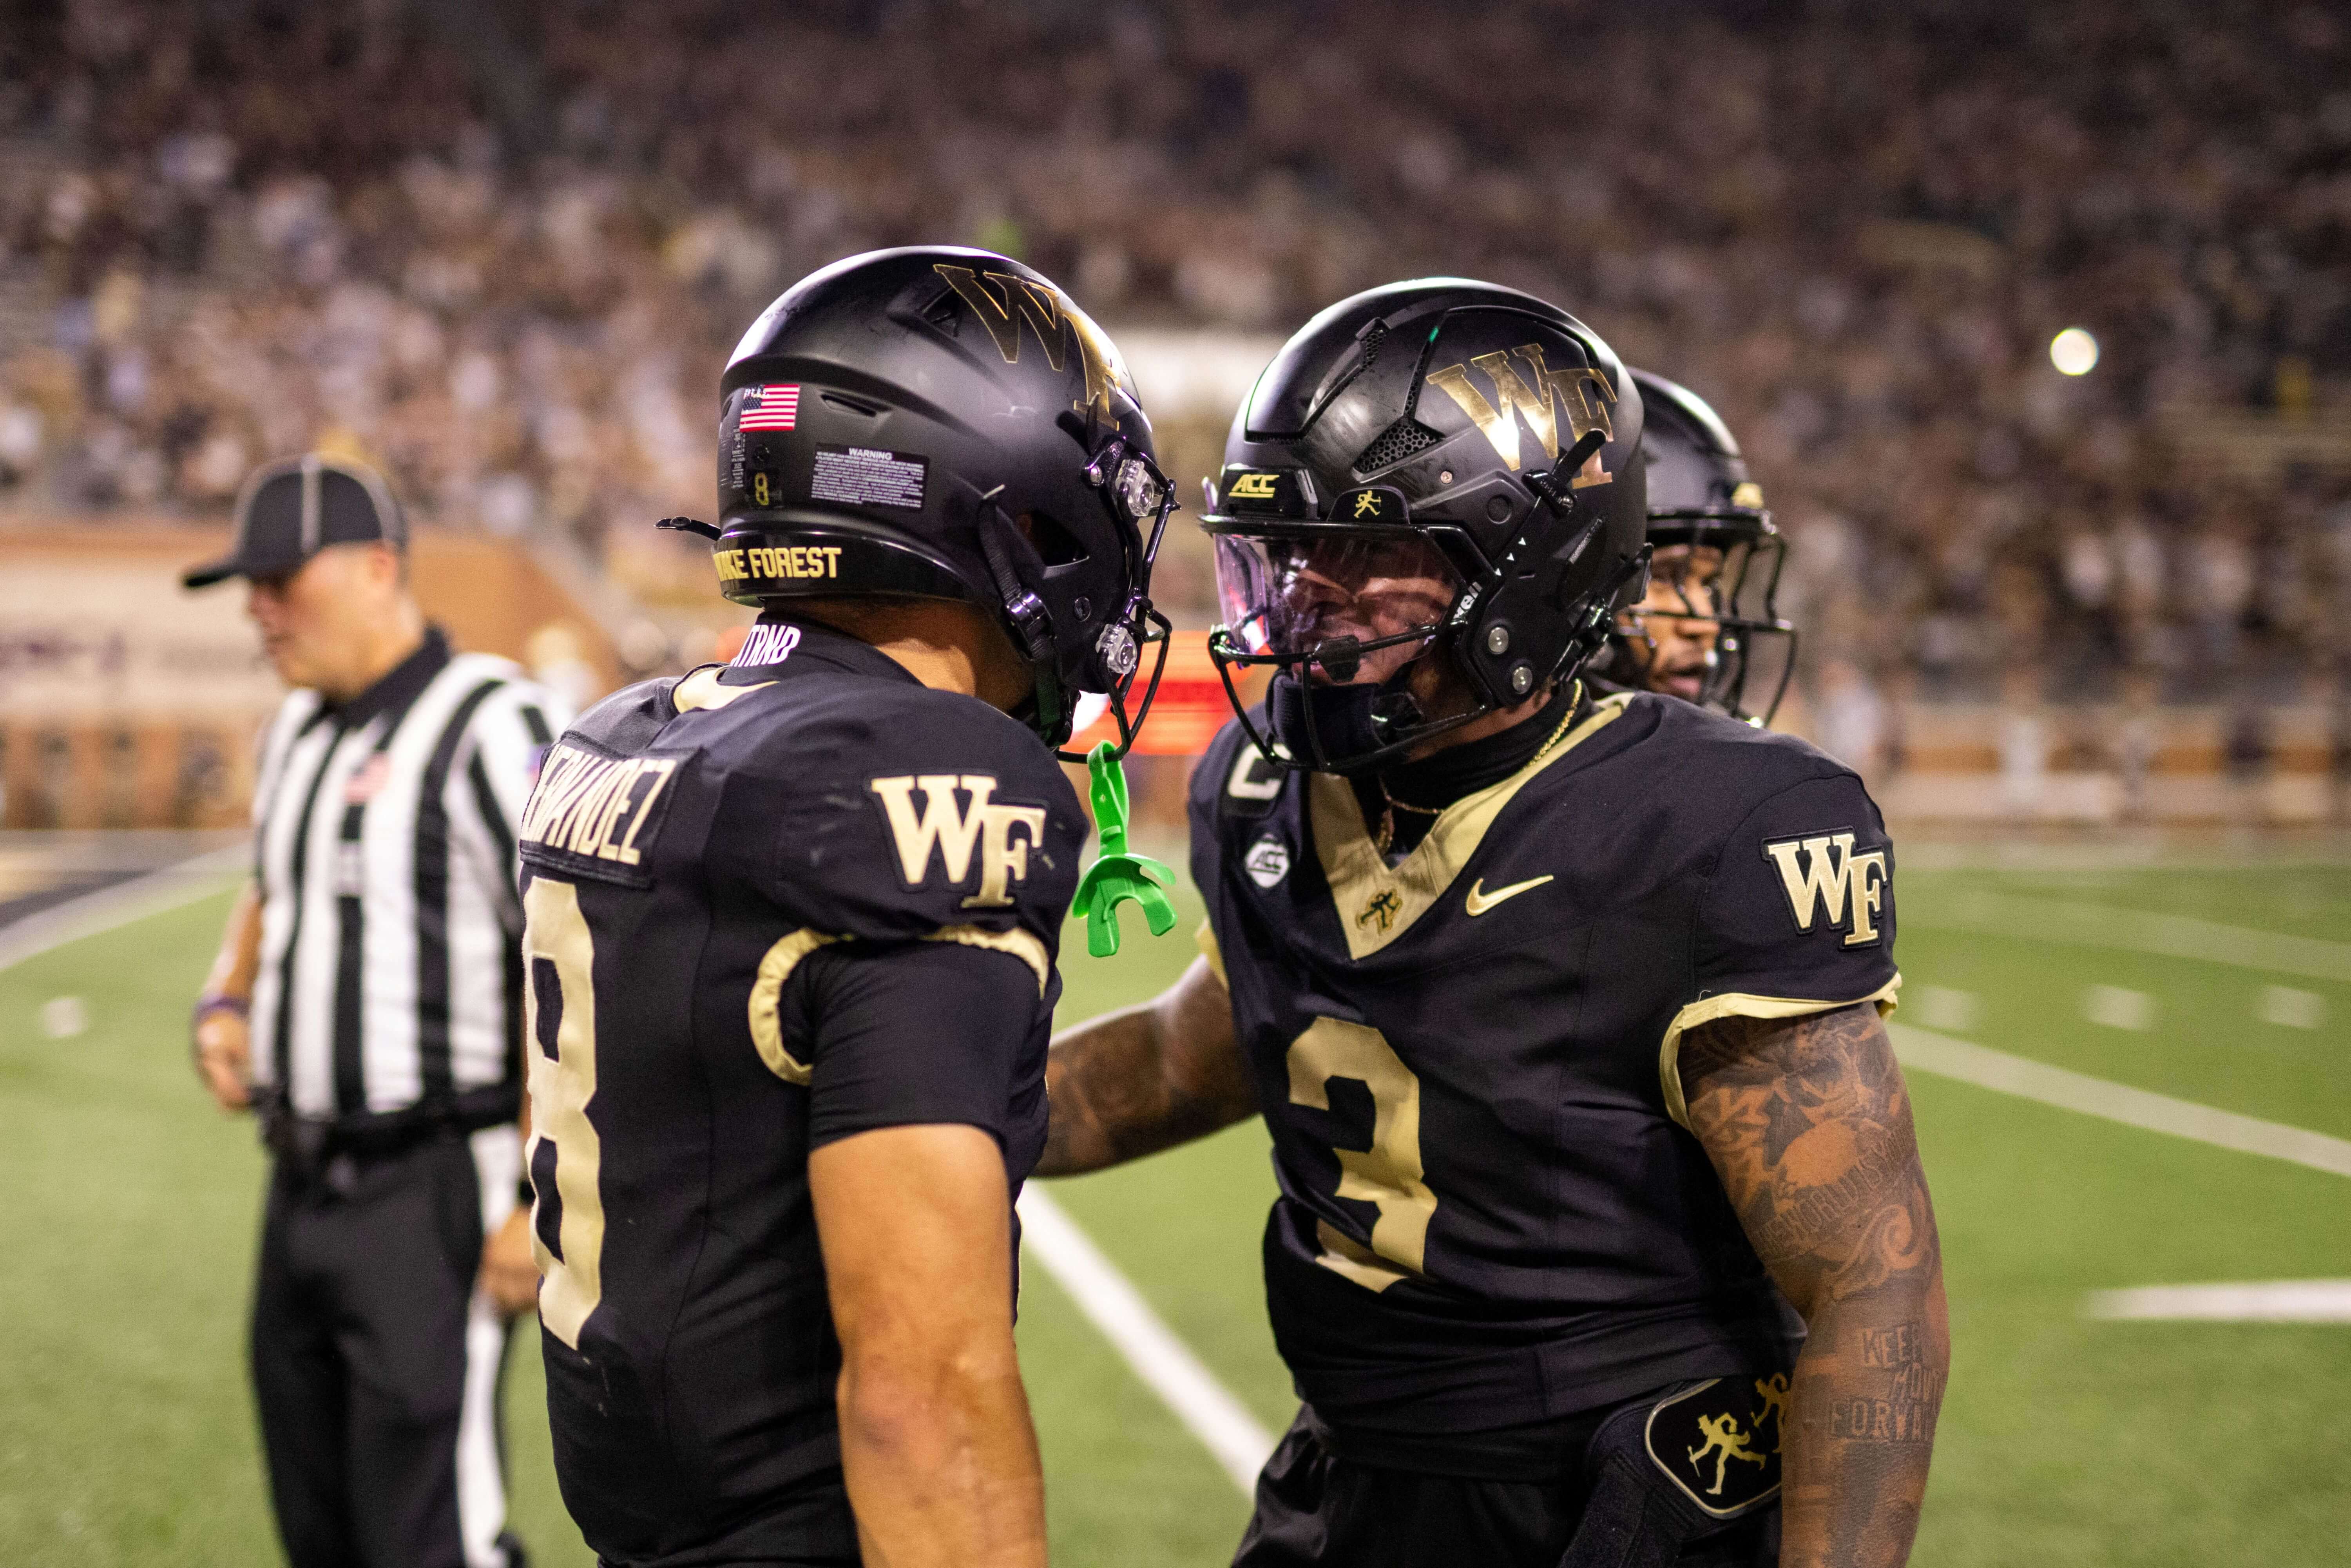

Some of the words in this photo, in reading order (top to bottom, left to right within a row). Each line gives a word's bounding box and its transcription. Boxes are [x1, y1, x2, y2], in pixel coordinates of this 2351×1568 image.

[1426, 343, 1617, 489] WF
[849, 447, 893, 460] WARNING
[754, 472, 769, 506] 8
[1231, 474, 1280, 493] ACC
[748, 547, 842, 578] FOREST
[871, 774, 1046, 908] WF
[1253, 850, 1284, 870] ACC
[1768, 833, 1887, 945] WF
[1286, 1016, 1438, 1293] 3
